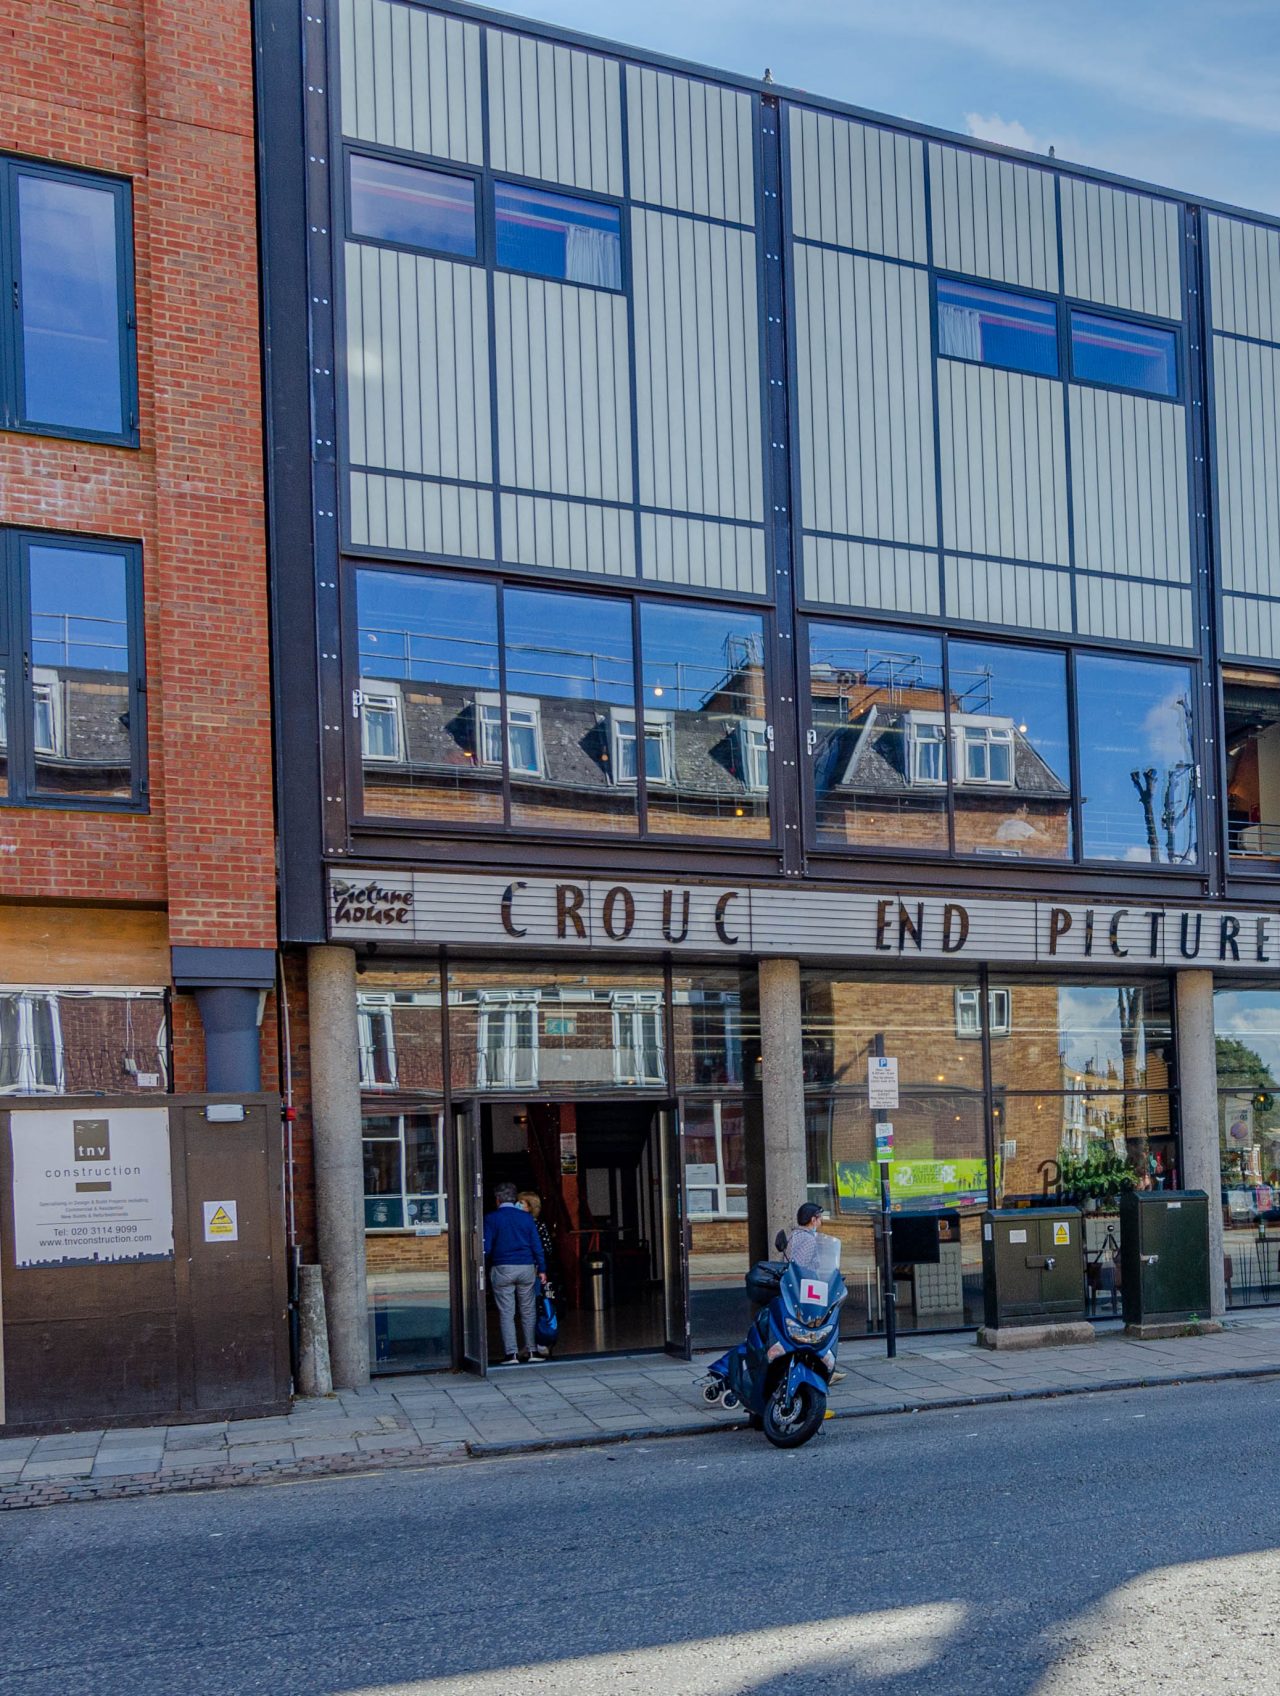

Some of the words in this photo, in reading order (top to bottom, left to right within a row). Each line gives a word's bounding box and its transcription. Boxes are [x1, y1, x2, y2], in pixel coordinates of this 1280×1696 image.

[331, 880, 414, 906] Picture
[335, 897, 409, 925] house
[501, 881, 739, 945] CROUC
[876, 899, 969, 953] END
[78, 1146, 106, 1156] tnv
[45, 1166, 141, 1178] construction
[54, 1228, 68, 1237] Tel:
[71, 1227, 88, 1236] 020
[91, 1226, 113, 1235] 3114
[115, 1225, 138, 1234] 9099
[40, 1234, 152, 1247] www.tnvconstruction.com
[807, 1285, 820, 1300] L
